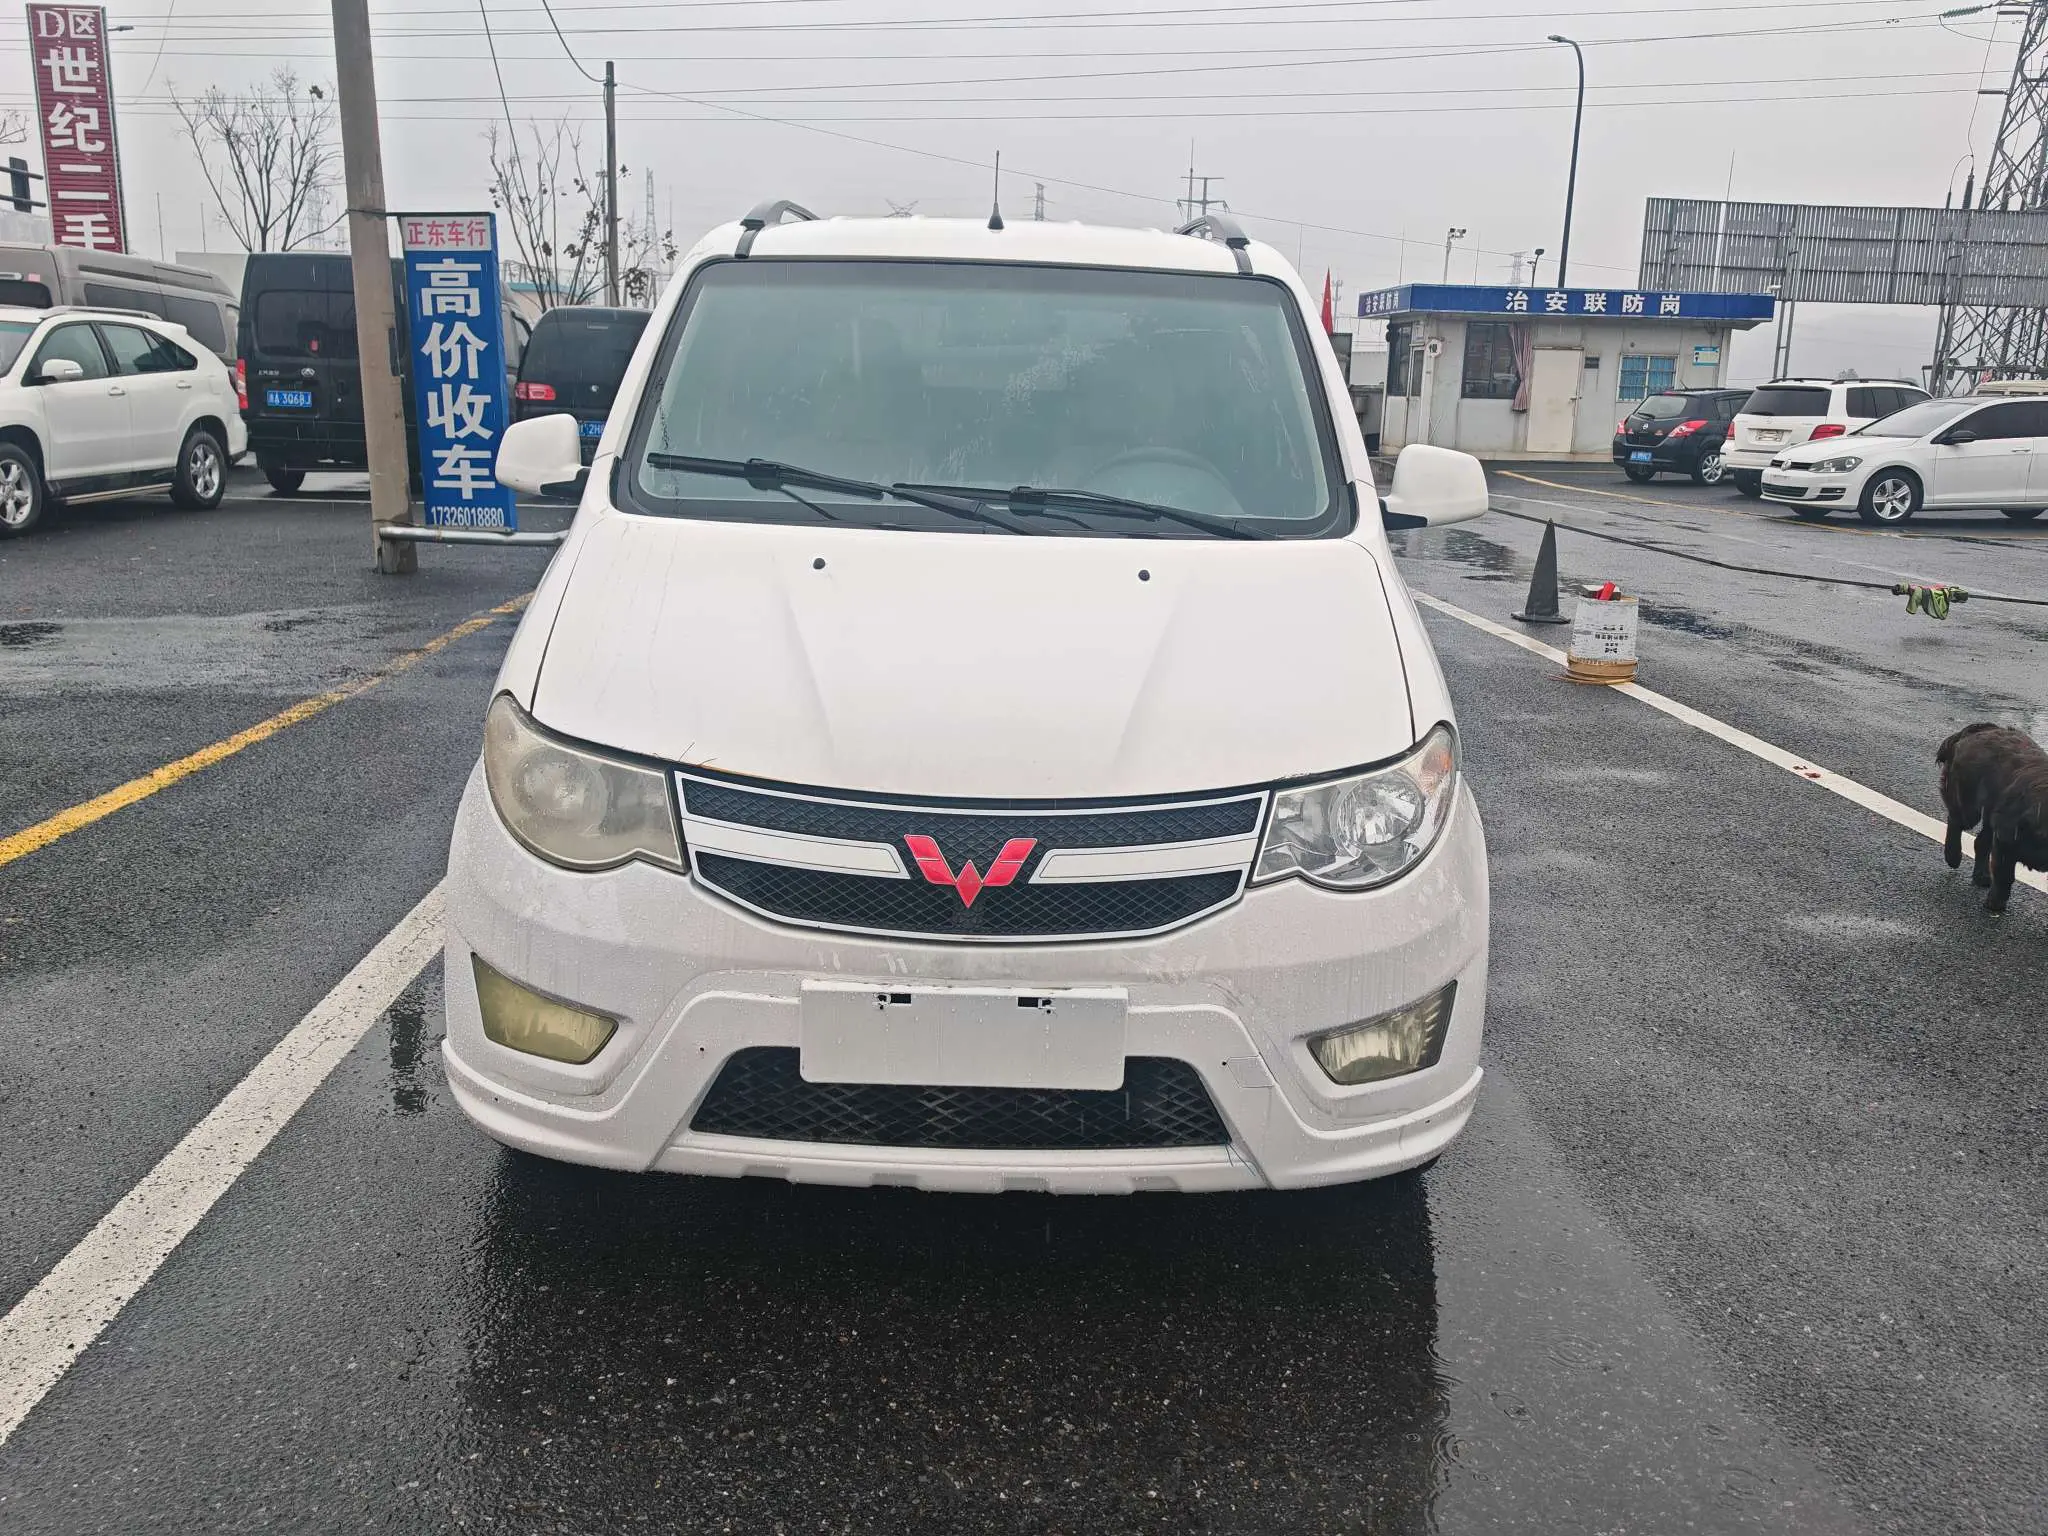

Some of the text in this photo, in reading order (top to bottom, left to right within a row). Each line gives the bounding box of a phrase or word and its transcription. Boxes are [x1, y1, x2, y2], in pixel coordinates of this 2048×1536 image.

[36, 9, 97, 39] D区
[406, 219, 486, 247] 正东车行
[1504, 290, 1681, 315] 治安联防岗
[415, 257, 496, 501] 高价收车
[431, 506, 505, 527] 17326018880
